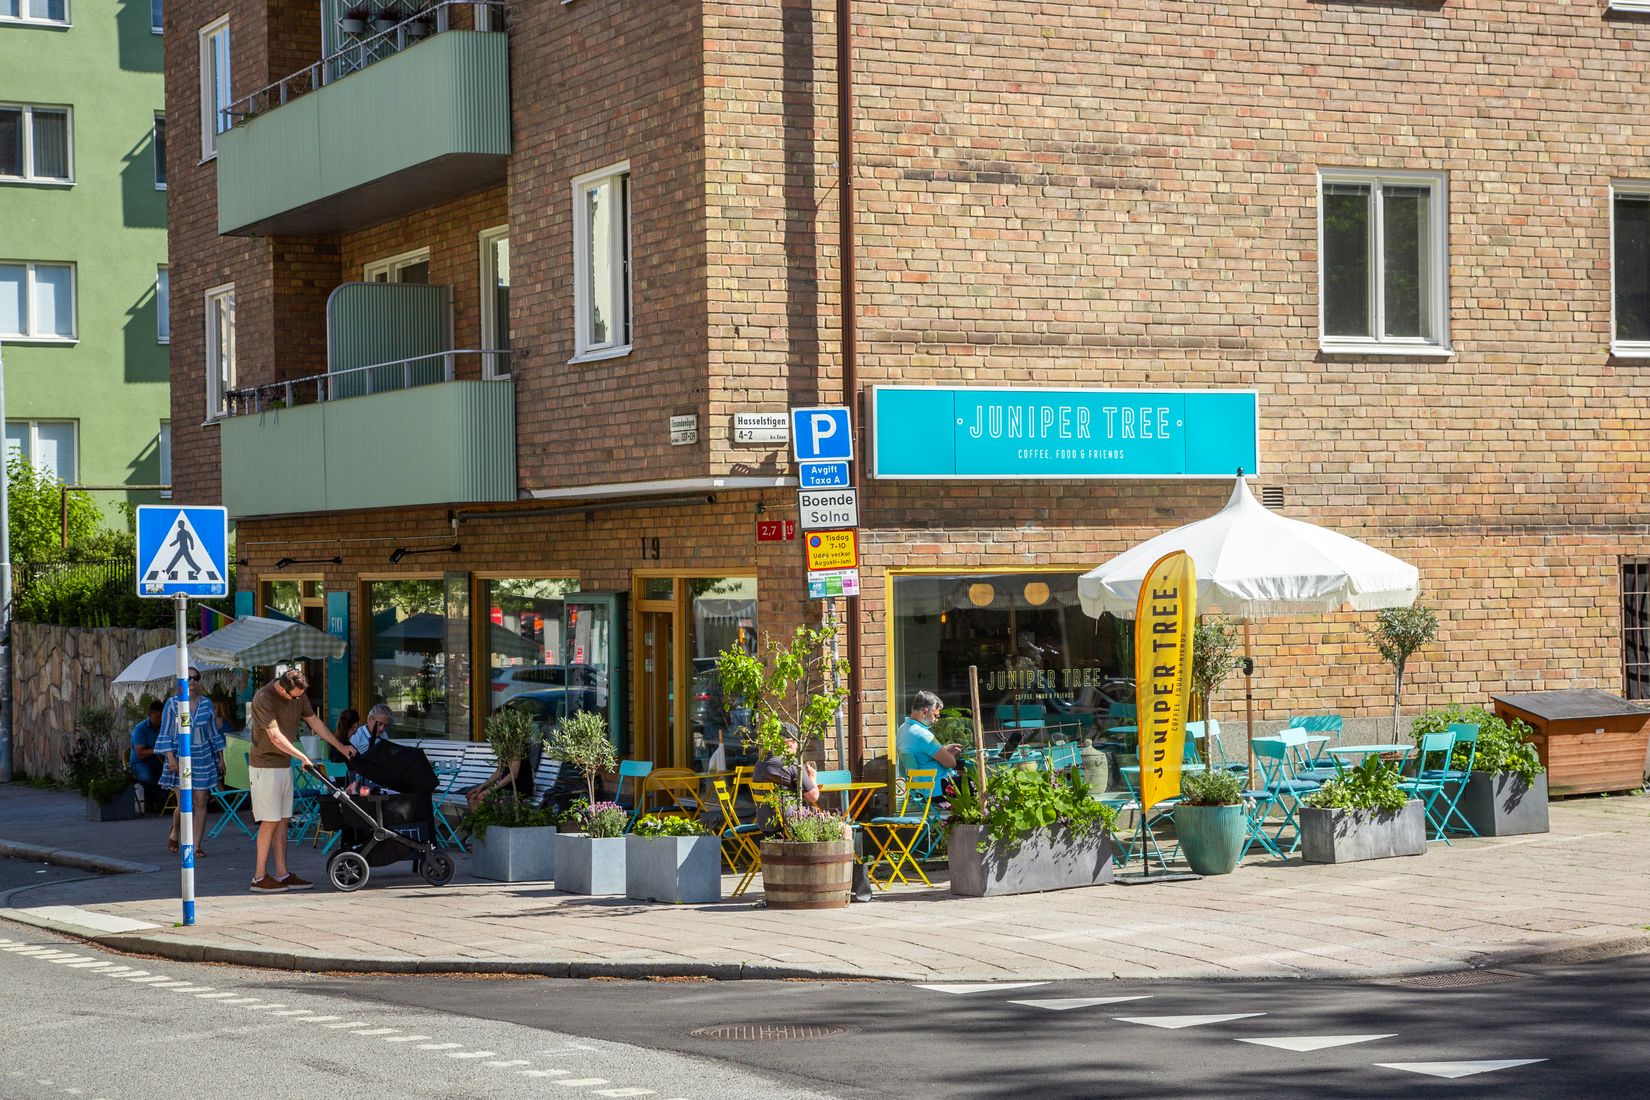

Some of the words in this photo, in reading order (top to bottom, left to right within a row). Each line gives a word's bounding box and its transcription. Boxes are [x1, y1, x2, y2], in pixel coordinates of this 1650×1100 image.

[737, 416, 786, 428] Hasselstigen
[969, 405, 1091, 439] JUNIPER
[1102, 406, 1170, 439] TREE
[738, 430, 753, 440] 4-2
[811, 413, 837, 455] P
[1018, 449, 1053, 460] COFFEE,
[1055, 449, 1077, 459] FOOD
[1080, 449, 1085, 459] &
[1088, 449, 1124, 459] FRIENDS
[811, 465, 837, 476] Avgift
[810, 476, 832, 485] Taxa
[833, 476, 841, 484] A
[802, 494, 854, 507] Boende
[811, 511, 850, 523] Solna
[761, 525, 777, 537] 2,7
[641, 536, 660, 560] 19
[814, 559, 852, 567] Augusti-Juni
[331, 616, 344, 633] FIKA
[1152, 587, 1178, 653] TREE
[986, 669, 1056, 690] JUNIPER
[1062, 667, 1101, 688] TREE
[1175, 676, 1183, 697] FOOD
[1153, 665, 1176, 779] JUNIPER
